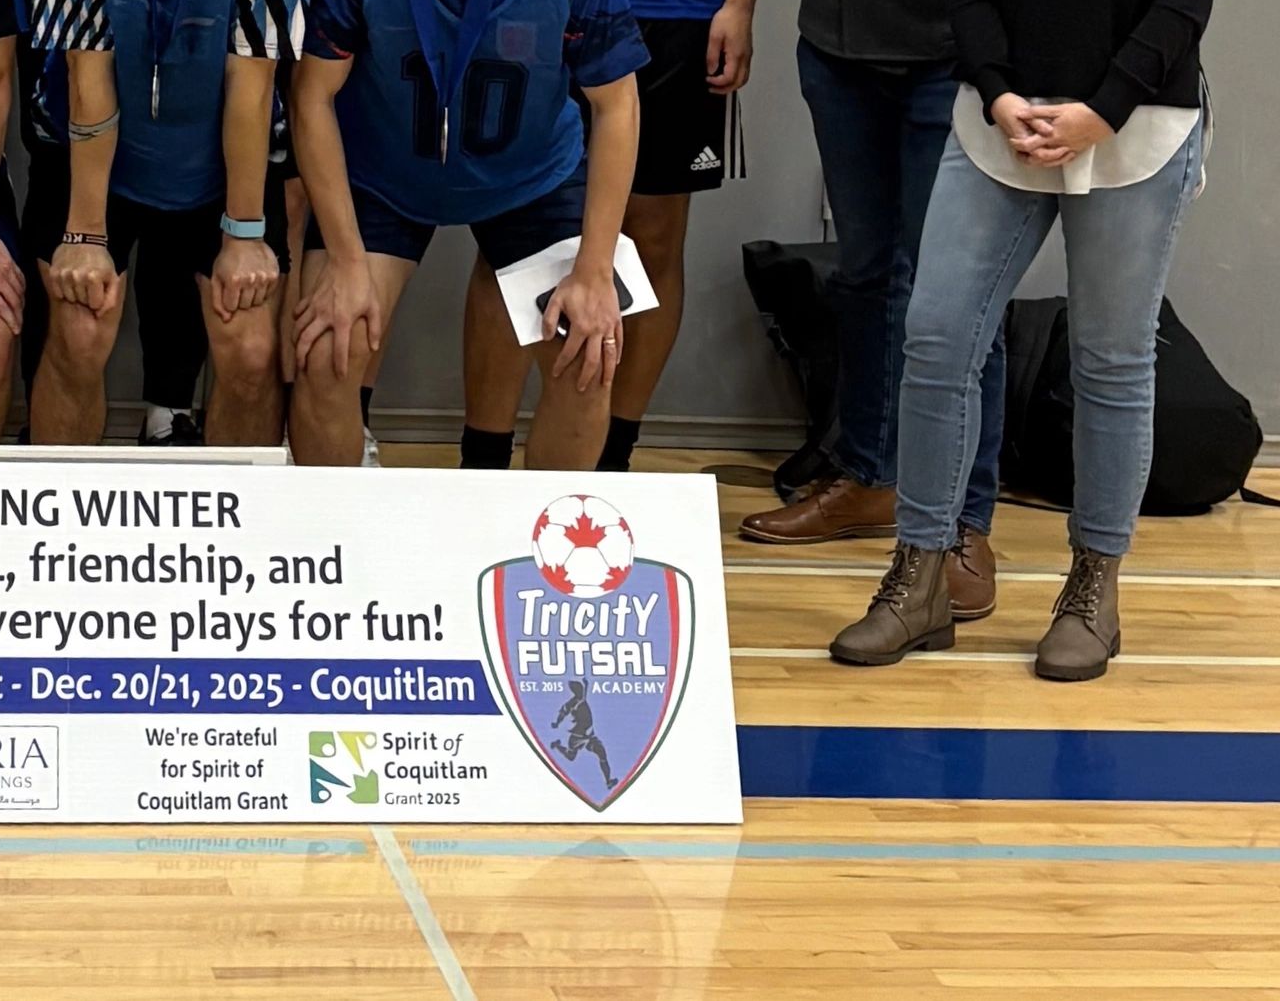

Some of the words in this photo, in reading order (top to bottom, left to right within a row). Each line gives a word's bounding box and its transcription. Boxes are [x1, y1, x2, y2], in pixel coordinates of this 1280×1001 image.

[400, 49, 530, 164] 10
[72, 489, 241, 528] WINTER
[29, 541, 255, 596] friendship,
[268, 545, 343, 585] and
[170, 599, 276, 652] plays
[288, 600, 351, 642] for
[362, 601, 444, 642] fun!
[517, 640, 667, 676] FUTSAL
[31, 667, 102, 700] Dec.
[112, 664, 200, 708] 20/21,
[210, 673, 284, 708] 2025
[310, 666, 475, 711] Coquitlam
[519, 681, 538, 692] EST.
[542, 681, 564, 692] 2015
[592, 681, 666, 694] ACADEMY
[145, 727, 199, 747] We're
[204, 727, 277, 747] Grateful
[383, 732, 438, 756] Spirit
[443, 733, 465, 757] of
[160, 759, 188, 779] for
[191, 759, 241, 783] Spirit
[245, 759, 265, 779] of
[384, 761, 488, 785] Coquitlam
[137, 791, 232, 815] Coquitlam
[237, 792, 289, 810] Grant
[384, 792, 424, 806] Grant
[426, 792, 461, 806] 2025
